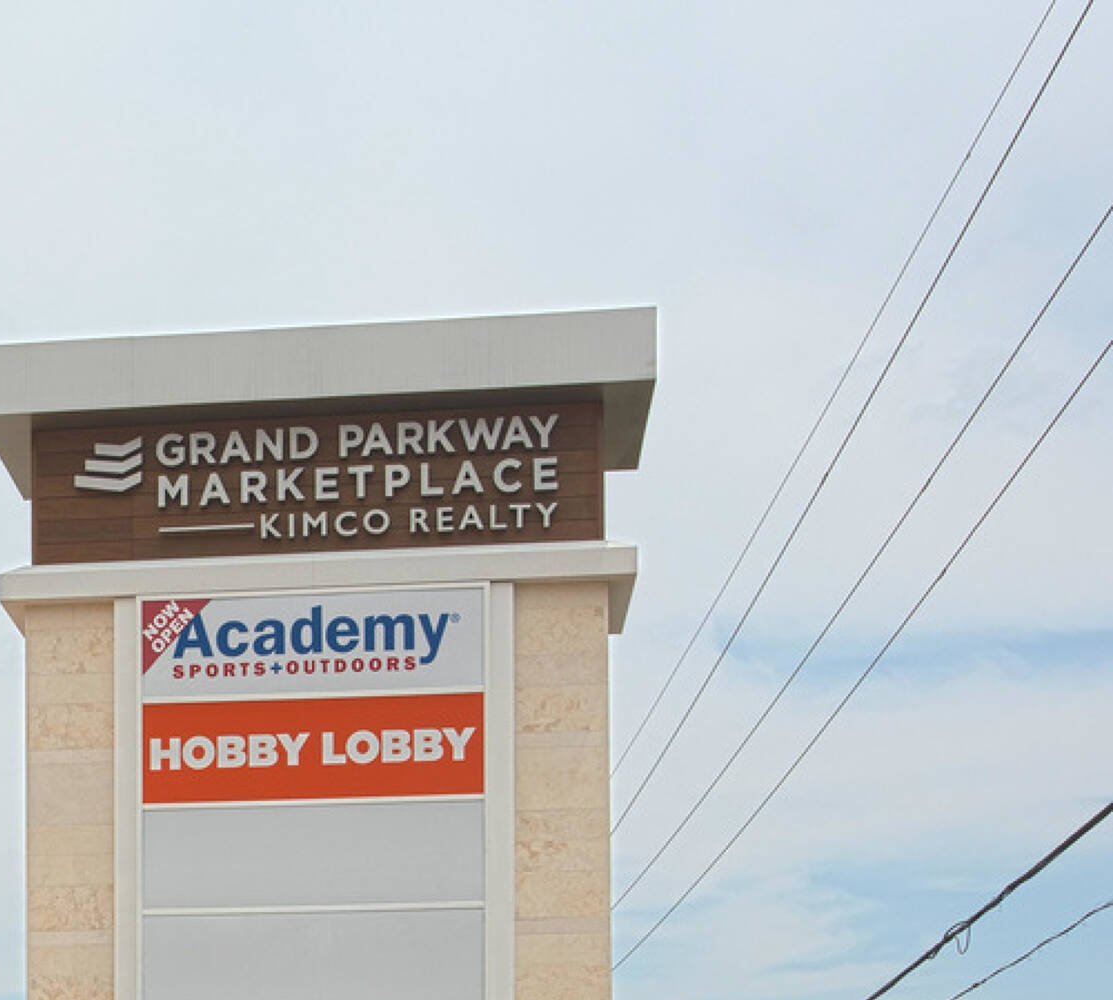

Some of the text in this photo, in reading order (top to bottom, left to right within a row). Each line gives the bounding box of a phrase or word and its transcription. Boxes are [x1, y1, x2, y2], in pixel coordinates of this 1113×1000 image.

[155, 413, 560, 467] GRAND PARKWAY
[157, 456, 560, 508] MARKETPLACE
[259, 502, 559, 539] KIMCO REALTY
[143, 600, 180, 641] NOW
[151, 607, 194, 653] OPEN
[173, 604, 449, 665] Academy
[149, 727, 476, 771] HOBBY LOBBY
